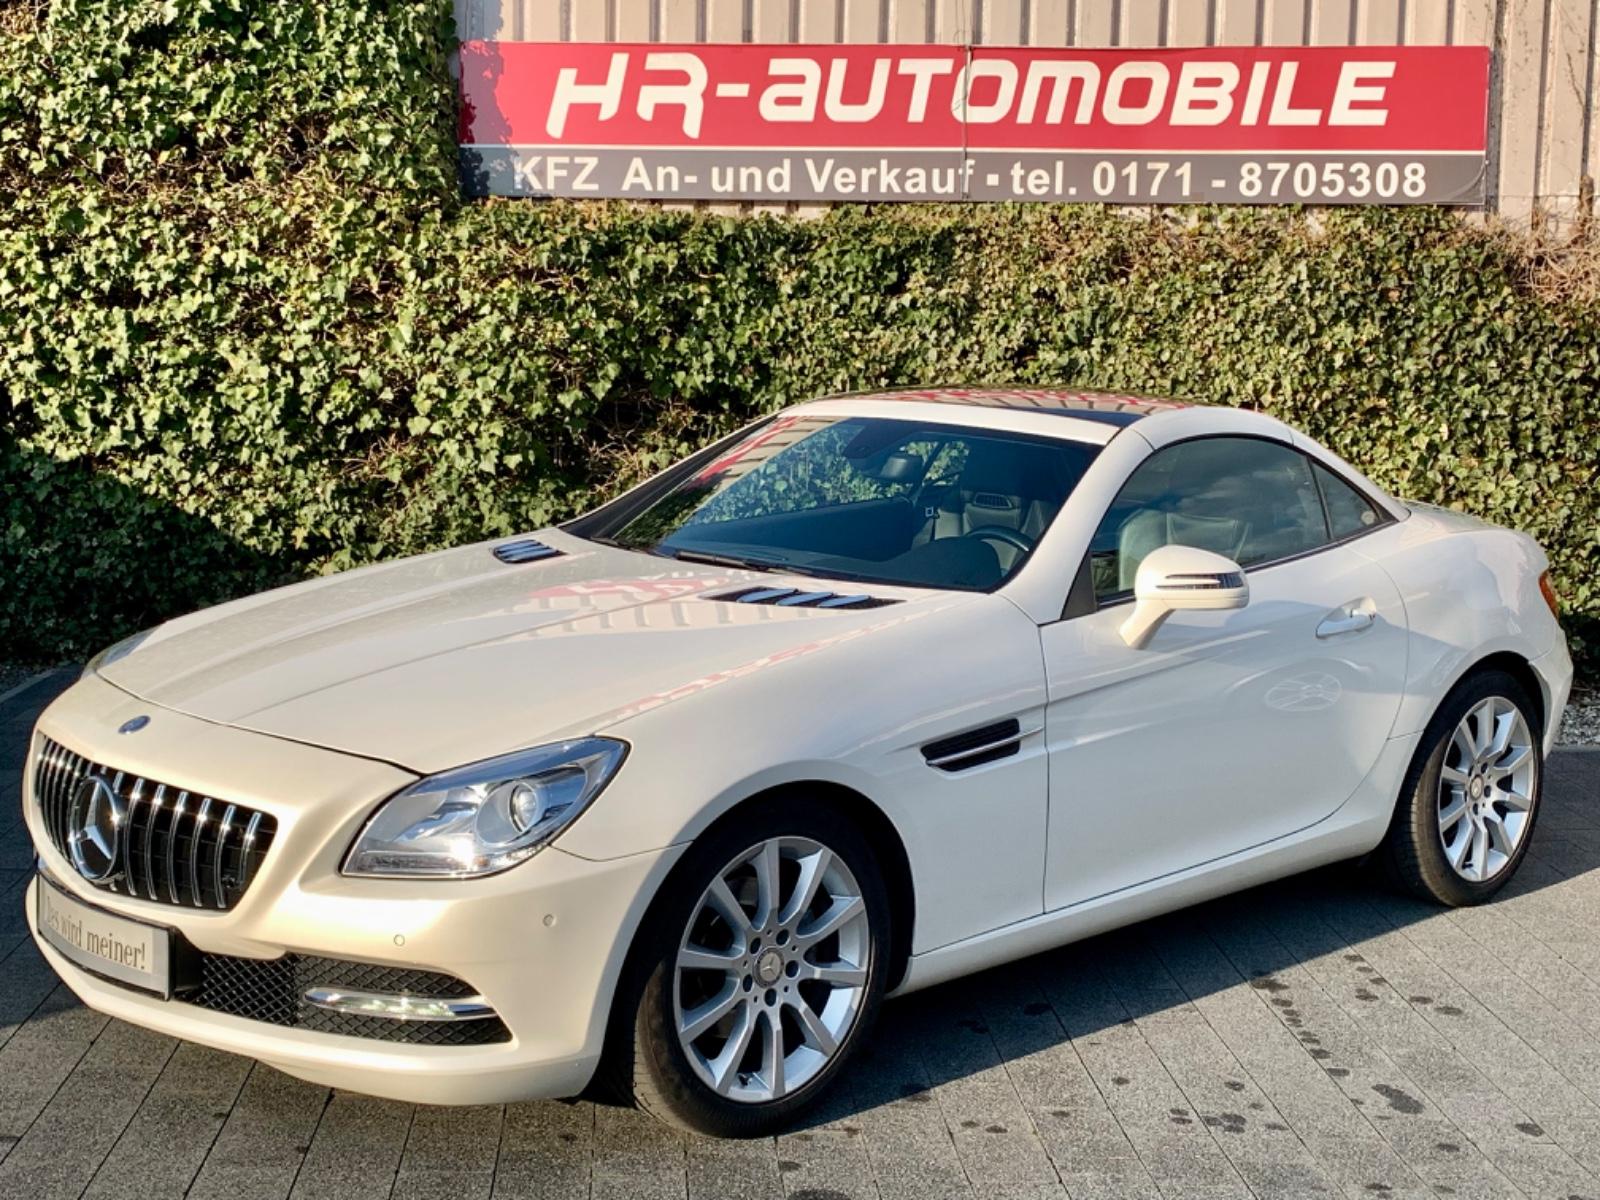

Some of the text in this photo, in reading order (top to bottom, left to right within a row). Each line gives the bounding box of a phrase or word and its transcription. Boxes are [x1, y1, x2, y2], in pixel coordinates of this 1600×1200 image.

[545, 52, 1397, 139] HR-AUTOMOBILE
[513, 156, 599, 192] KFZ
[621, 156, 698, 193] An-
[711, 158, 792, 193] und
[804, 158, 976, 194] Verkauf
[1010, 160, 1077, 196] tel.
[1092, 161, 1193, 197] 0171
[1238, 162, 1427, 198] 8705308
[61, 914, 83, 948] wird
[86, 931, 146, 970] meiner!
